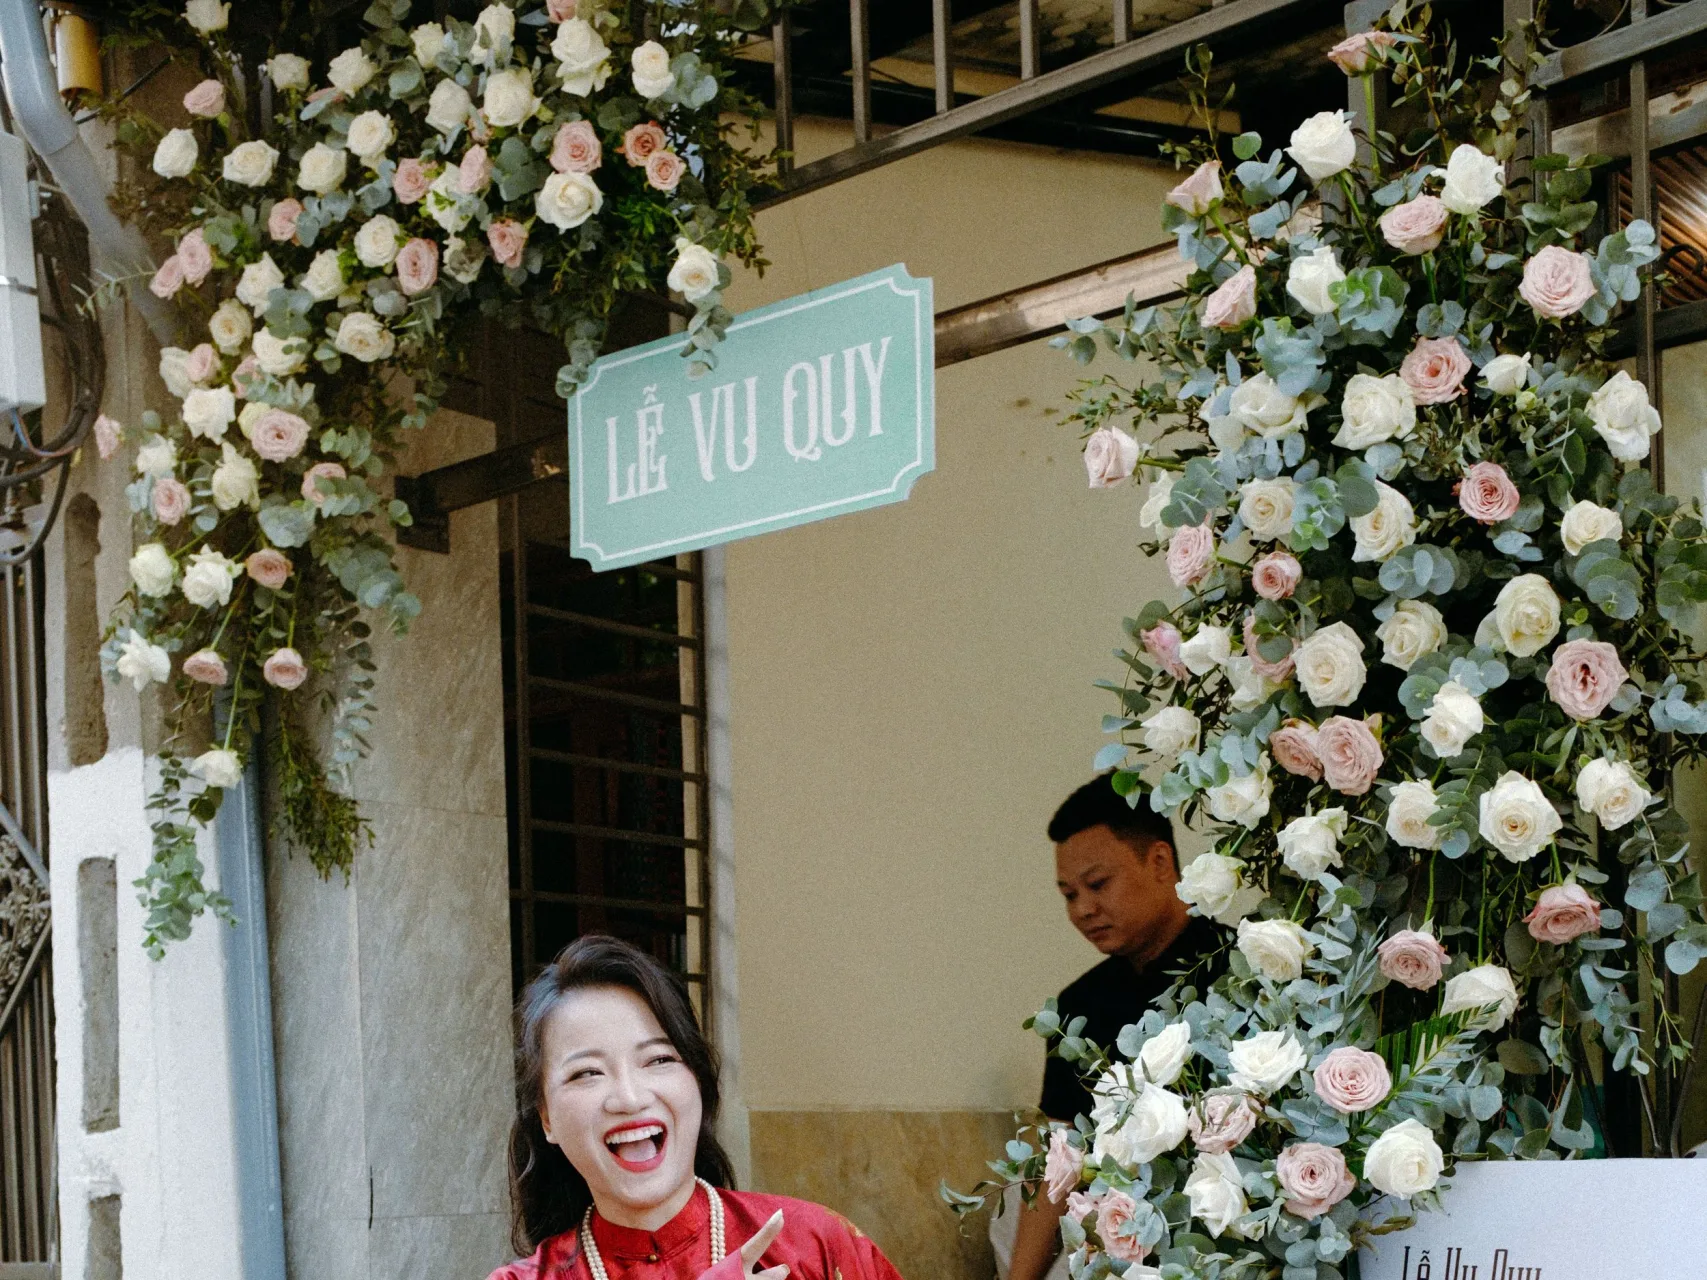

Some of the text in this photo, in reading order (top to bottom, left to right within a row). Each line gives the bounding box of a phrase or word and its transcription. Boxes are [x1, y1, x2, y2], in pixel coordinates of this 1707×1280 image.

[606, 336, 893, 504] LỄ VU QUY
